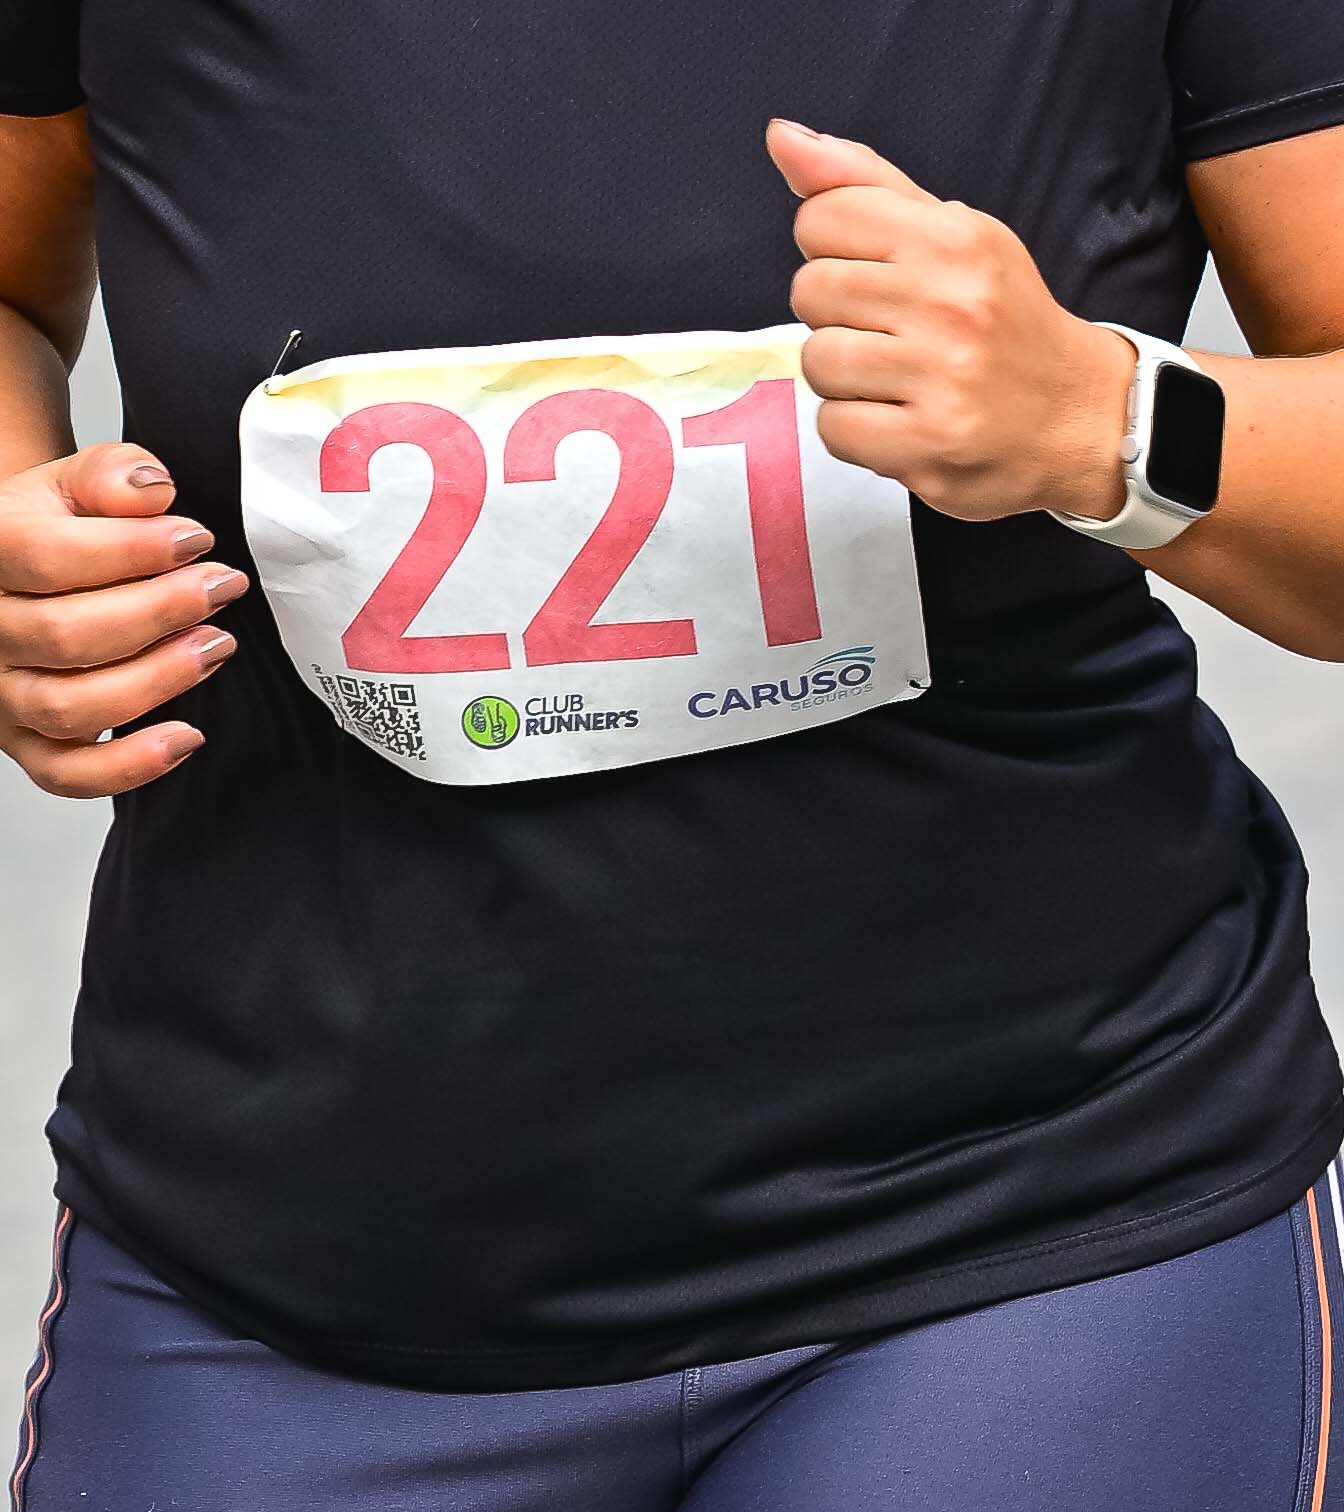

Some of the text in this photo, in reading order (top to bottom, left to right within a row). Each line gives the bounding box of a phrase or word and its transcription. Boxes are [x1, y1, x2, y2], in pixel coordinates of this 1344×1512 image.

[319, 378, 822, 675] 221
[524, 694, 584, 714] CLUB
[687, 663, 873, 718] CARUSO
[790, 683, 874, 712] SEGUROS
[524, 709, 640, 738] RUNNER'S
